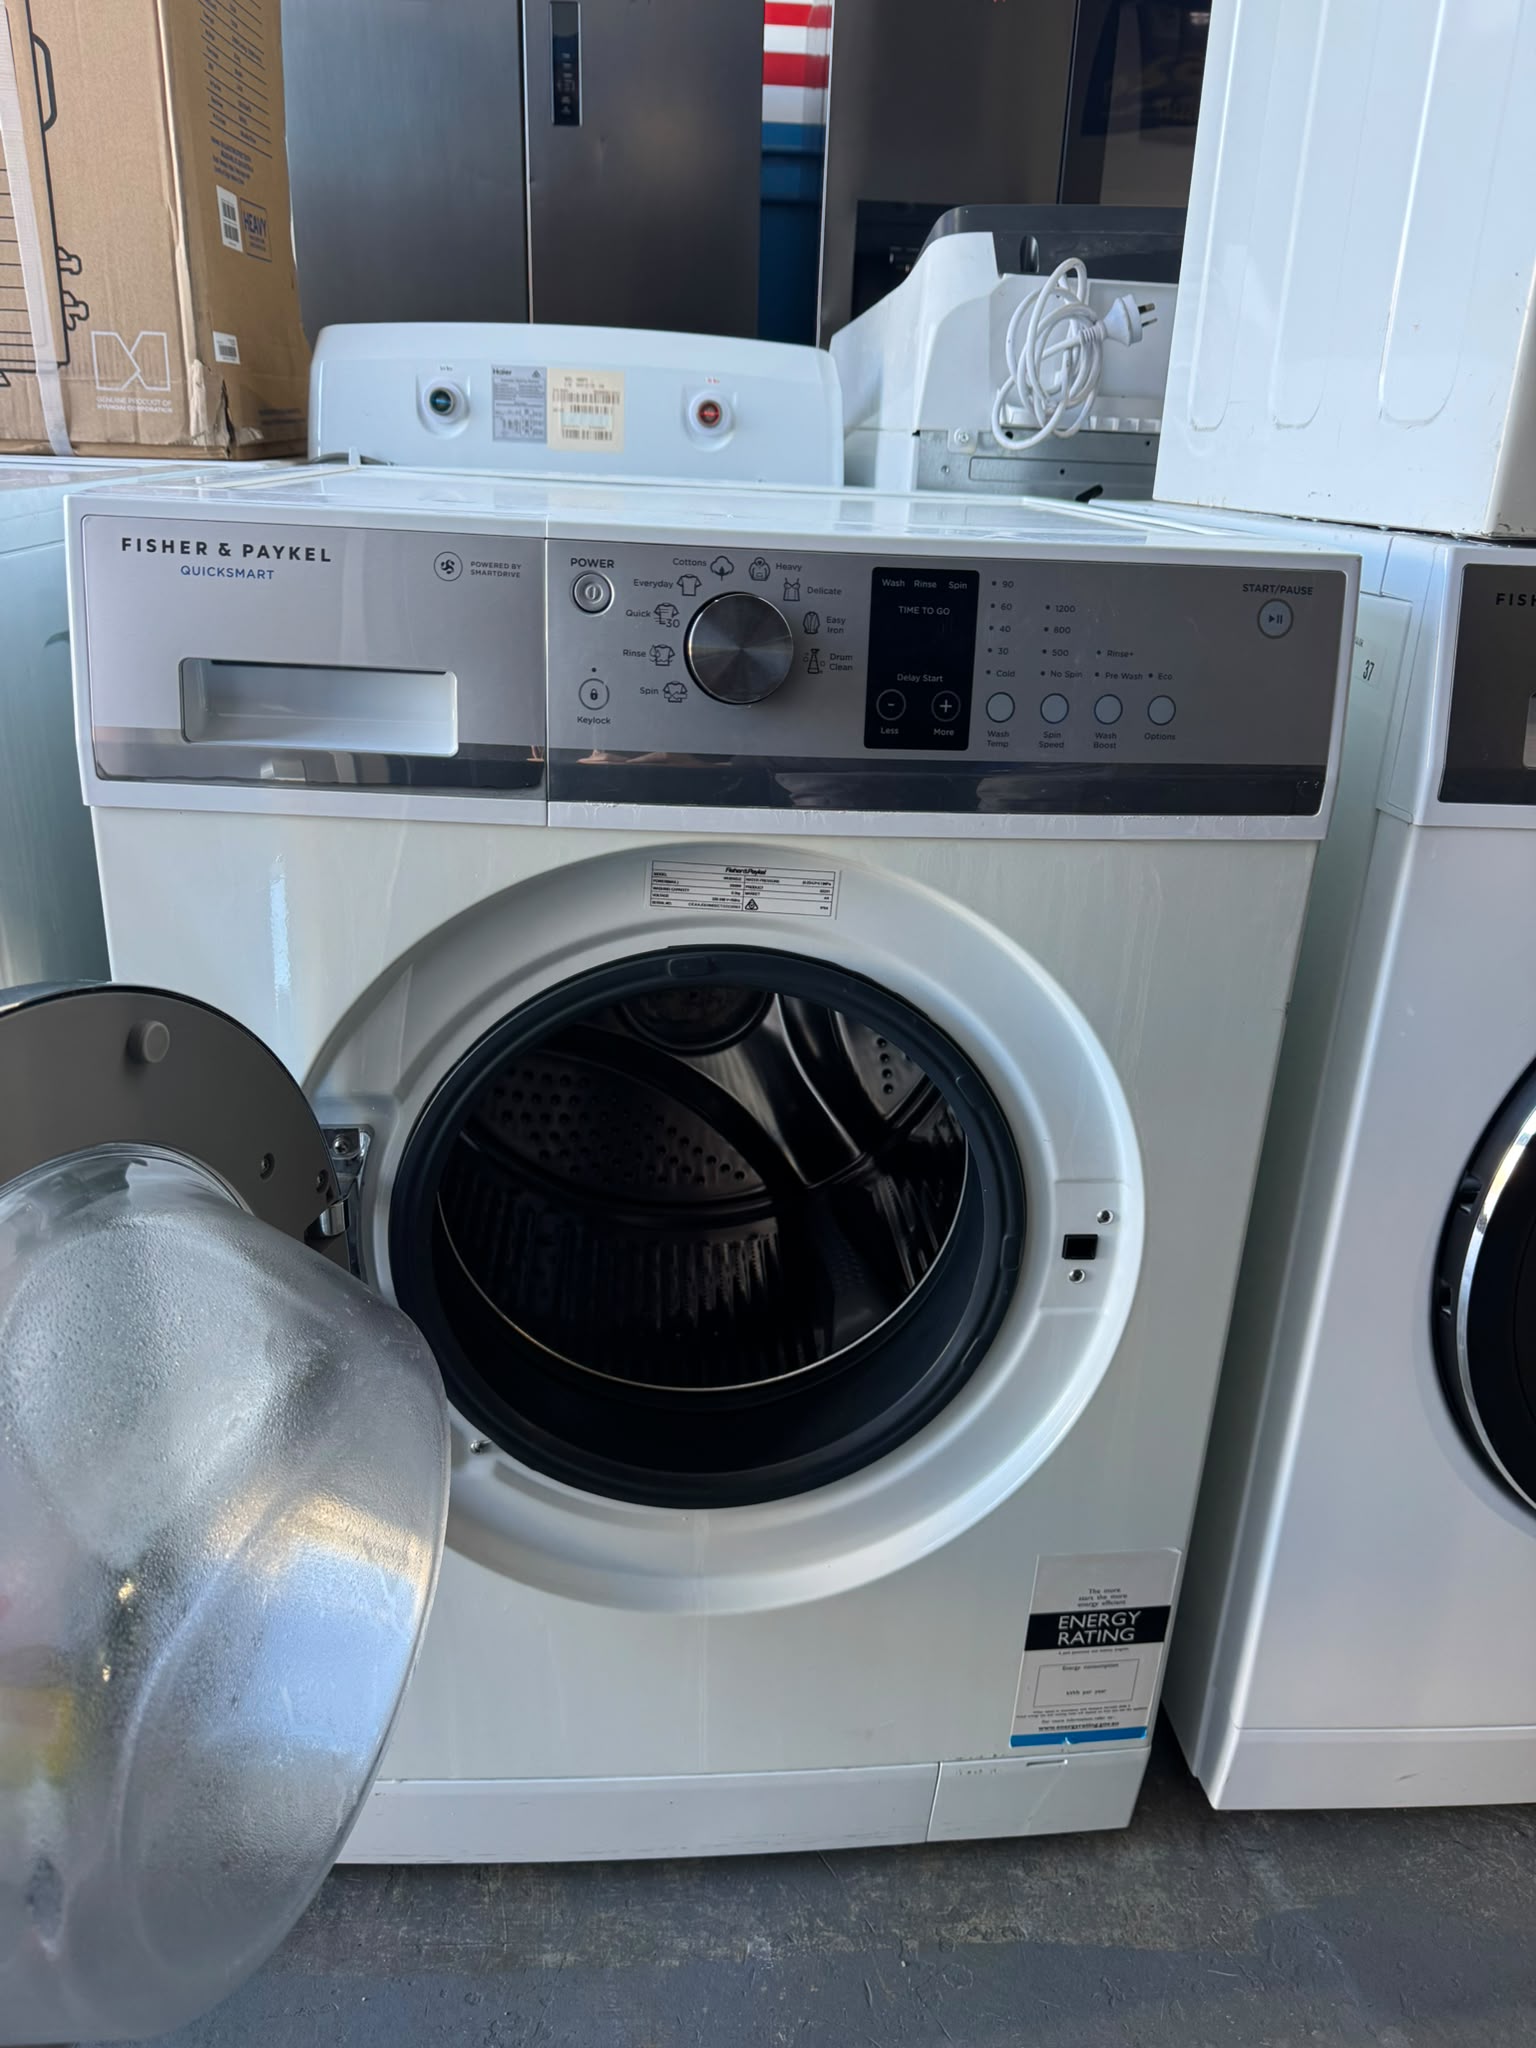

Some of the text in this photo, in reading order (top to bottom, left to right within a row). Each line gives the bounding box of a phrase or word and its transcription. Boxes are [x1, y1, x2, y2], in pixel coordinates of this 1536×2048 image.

[243, 210, 267, 237] HEAVY
[121, 537, 331, 563] FISHER & PAYKEL
[470, 560, 522, 572] POWERED BY
[570, 558, 614, 569] POWER
[672, 557, 707, 567] Cottons
[180, 565, 274, 580] QUICKSMART
[775, 562, 802, 573] Heavy
[470, 569, 521, 579] SMARTDRIVE
[633, 578, 674, 590] Everyday
[882, 578, 968, 591] Wash Rinse Spin
[1002, 580, 1014, 589] 90
[807, 586, 842, 596] Delicate
[1242, 583, 1313, 596] START/PAUSE
[625, 608, 651, 619] Quick
[898, 605, 950, 616] TIME TO GO
[1055, 604, 1076, 613] 1200
[665, 618, 680, 628] 30
[826, 616, 847, 626] Easy
[827, 625, 844, 635] Iron
[623, 649, 647, 659] Rinse
[829, 653, 853, 662] Drum
[1052, 649, 1069, 658] 500
[1107, 649, 1134, 659] Rinse+
[829, 662, 853, 672] Clean
[1363, 659, 1375, 681] 37
[897, 673, 944, 684] Delay Start
[996, 669, 1015, 678] Cold
[1050, 670, 1083, 680] No Spin
[1105, 671, 1143, 681] Pre Wash
[1157, 672, 1173, 681] Eco
[640, 686, 659, 696] Spin
[577, 715, 611, 726] Keylock
[880, 726, 899, 736] Less
[933, 727, 954, 737] More
[987, 730, 1009, 739] Wash
[1043, 730, 1061, 741] Spin
[1095, 731, 1117, 740] Wash
[1144, 731, 1176, 742] Options
[987, 740, 1009, 750] Temp
[1039, 740, 1065, 751] Speed
[1093, 741, 1117, 750] Boost
[1058, 1610, 1142, 1630] ENERGY
[1057, 1627, 1135, 1647] RATING
